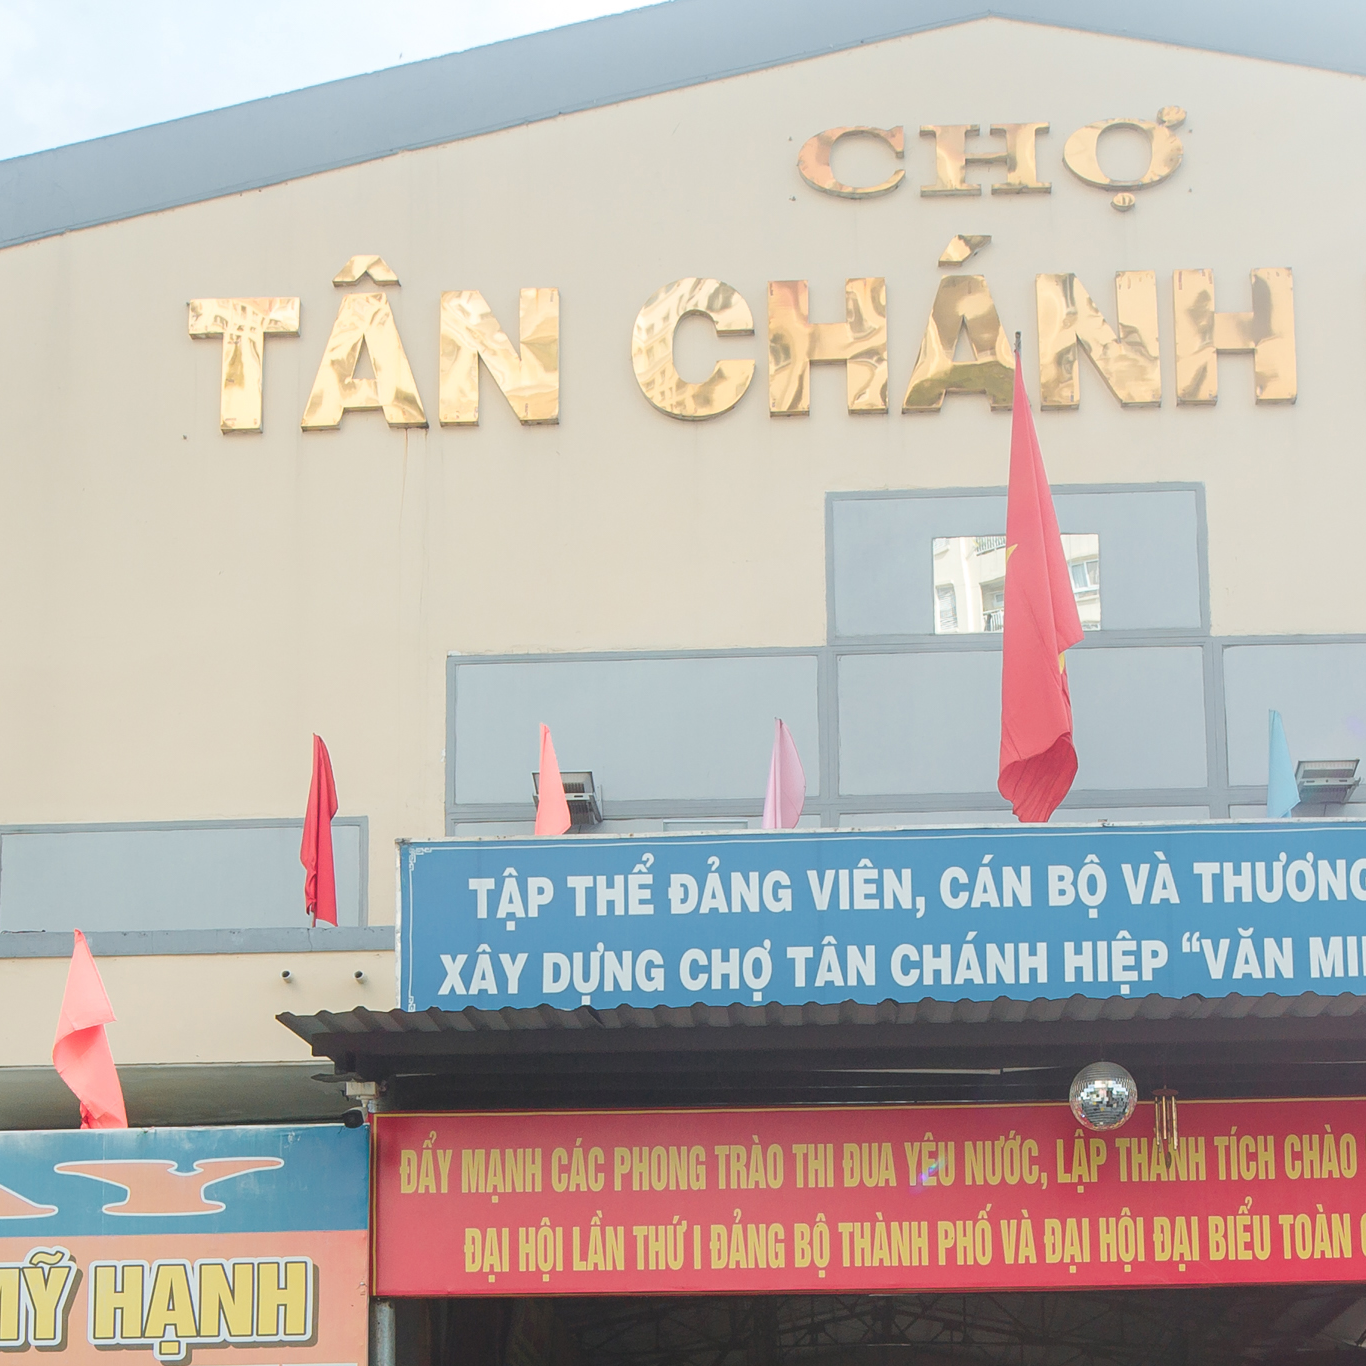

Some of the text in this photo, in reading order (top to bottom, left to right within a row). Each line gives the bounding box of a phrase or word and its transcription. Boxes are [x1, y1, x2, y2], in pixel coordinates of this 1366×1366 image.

[797, 105, 1188, 213] CHỢ
[186, 254, 563, 437] TÂN
[631, 232, 1298, 422] CHÁNH
[469, 868, 554, 931] TẬP
[567, 853, 655, 917] THỂ
[668, 856, 792, 915] ĐẢNG
[807, 859, 926, 918] VIÊN,
[940, 854, 1033, 908] CÁN
[1047, 854, 1108, 918] BỘ
[1121, 851, 1180, 904] VÀ
[437, 943, 529, 996] XÂY
[542, 942, 665, 1006] DỰNG
[679, 938, 774, 1002] CHỢ
[787, 936, 876, 988] TÂN
[905, 931, 1048, 986] CHÁNH
[1064, 930, 1169, 994] HIỆP
[400, 1130, 453, 1194] ĐẨY
[462, 1148, 542, 1203] MẠNH
[551, 1137, 605, 1193] CÁC
[615, 1145, 706, 1192] PHONG
[715, 1134, 785, 1191] TRÀO
[793, 1142, 834, 1189] THI
[843, 1140, 898, 1188] ĐUA
[906, 1132, 957, 1187] YÊU
[965, 1128, 1049, 1191] NƯỚC,
[1057, 1129, 1107, 1193] LẬP
[1215, 1125, 1276, 1181] TÍCH
[1284, 1123, 1357, 1180] CHÀO
[465, 1226, 511, 1283] ĐẠI
[519, 1216, 565, 1281] HỘI
[572, 1210, 625, 1272] LẦN
[633, 1219, 687, 1271] THỨ
[693, 1223, 702, 1270] I
[710, 1207, 786, 1269] ĐẢNG
[794, 1211, 831, 1278] BỘ
[838, 1210, 929, 1267] THÀNH
[937, 1201, 993, 1265] PHỐ
[1001, 1208, 1037, 1264] VÀ
[1044, 1218, 1092, 1273] ĐẠI
[1098, 1207, 1146, 1273] HỘI
[1153, 1215, 1200, 1272] ĐẠI
[1208, 1195, 1271, 1261] BIỂU
[1278, 1201, 1352, 1259] TOÀN
[88, 1255, 319, 1363] HẠNH
